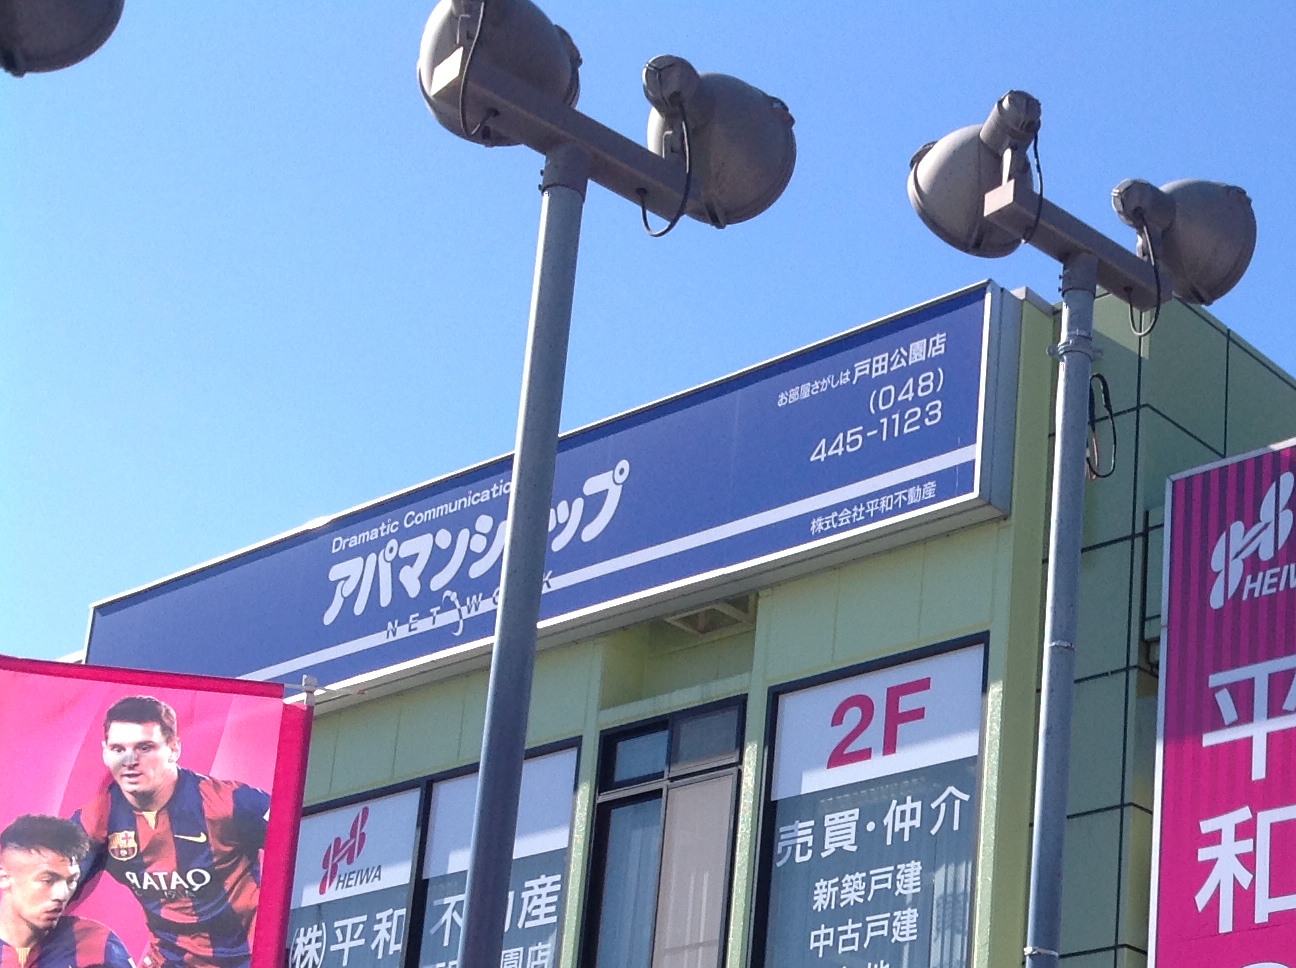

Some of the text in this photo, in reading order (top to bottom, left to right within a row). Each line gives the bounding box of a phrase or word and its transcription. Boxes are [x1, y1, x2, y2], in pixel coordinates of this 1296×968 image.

[777, 332, 947, 407] お部屋さがしは 戸田公園店
[869, 368, 945, 414] (048)
[810, 401, 943, 463] 445-1123
[331, 479, 511, 554] Dramatic Communicatio
[811, 481, 937, 535] 株式会社平和不動産
[324, 459, 631, 626] アパマンシップ
[827, 677, 932, 770] 2F
[776, 786, 970, 867] 売買・仲介
[335, 864, 382, 891] HEIWA
[812, 860, 923, 912] 新築戸建
[809, 907, 919, 958] 中古戸建
